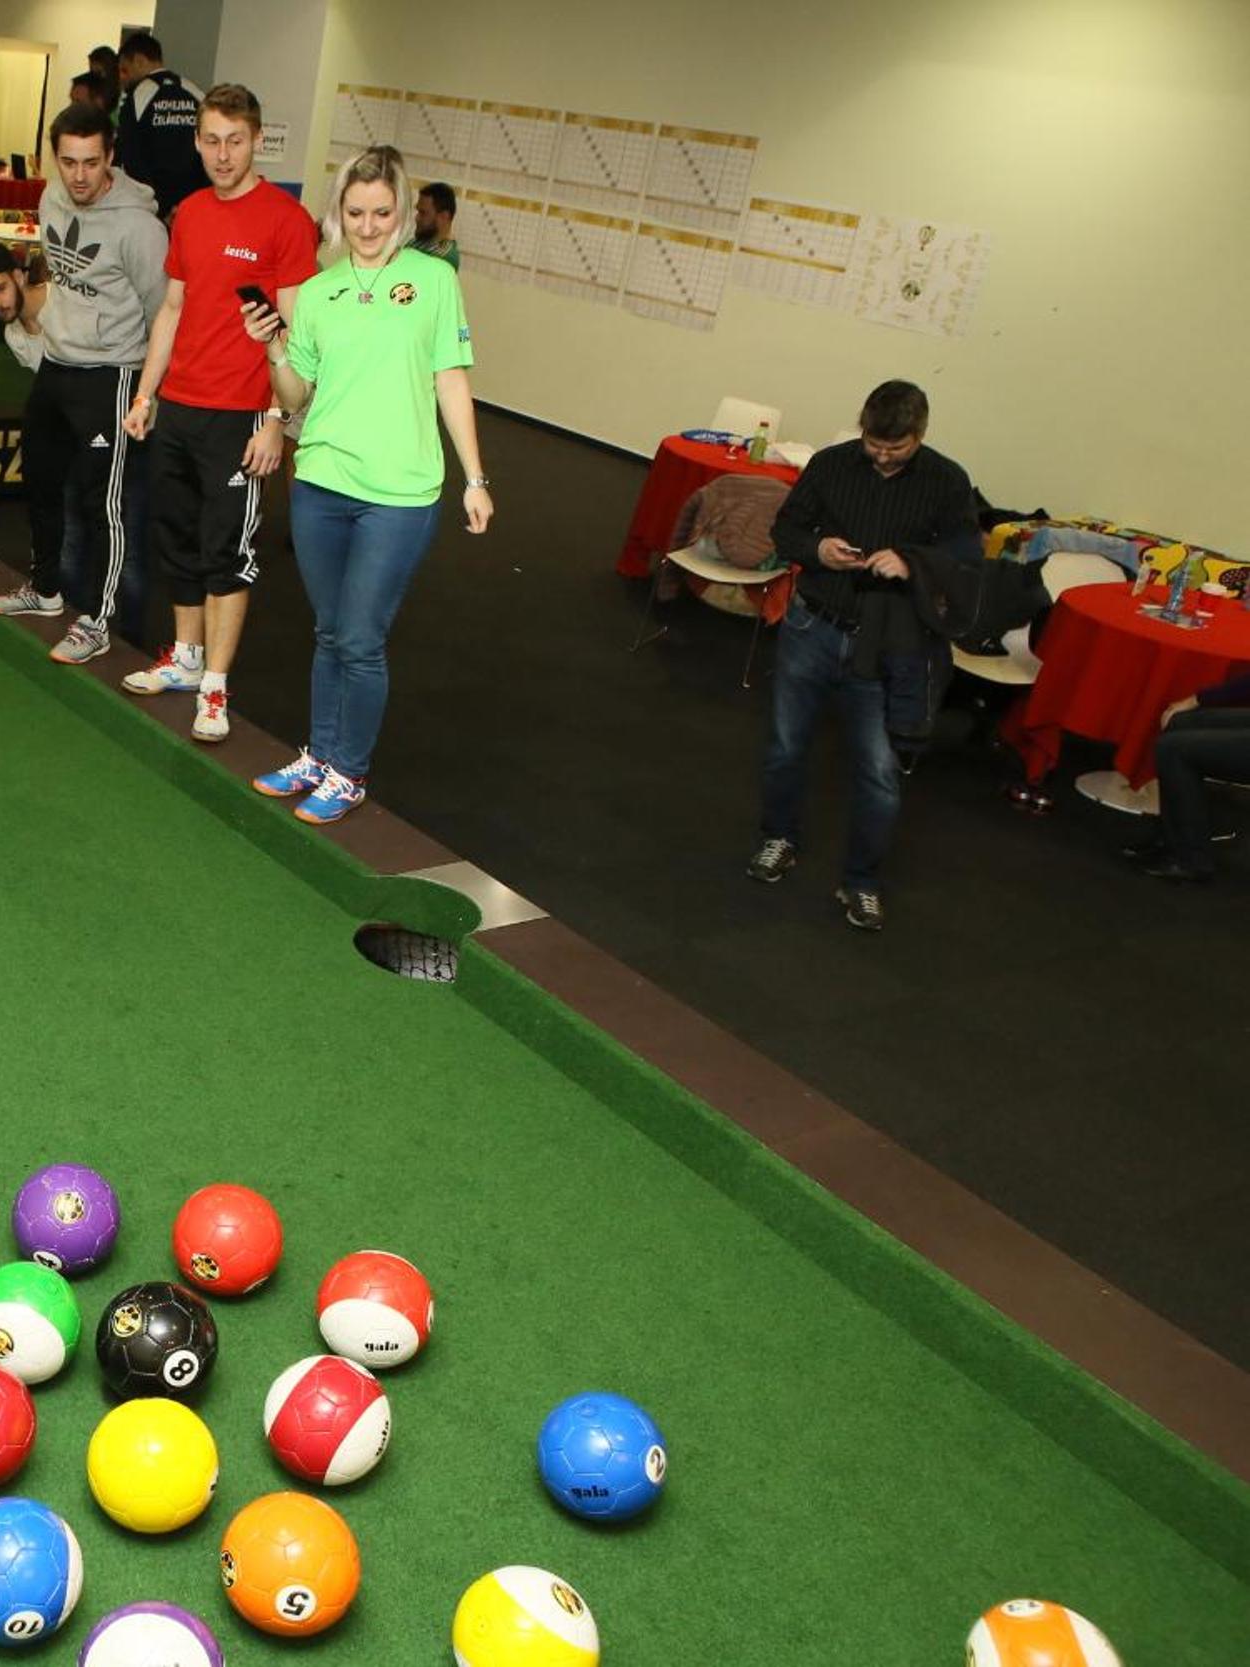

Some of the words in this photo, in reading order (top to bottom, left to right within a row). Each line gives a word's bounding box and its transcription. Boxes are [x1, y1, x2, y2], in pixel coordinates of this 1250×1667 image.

[364, 1341, 399, 1352] gala
[169, 1358, 195, 1381] 8
[571, 1485, 609, 1499] gala
[282, 1591, 309, 1616] 5
[7, 1619, 40, 1630] 10
